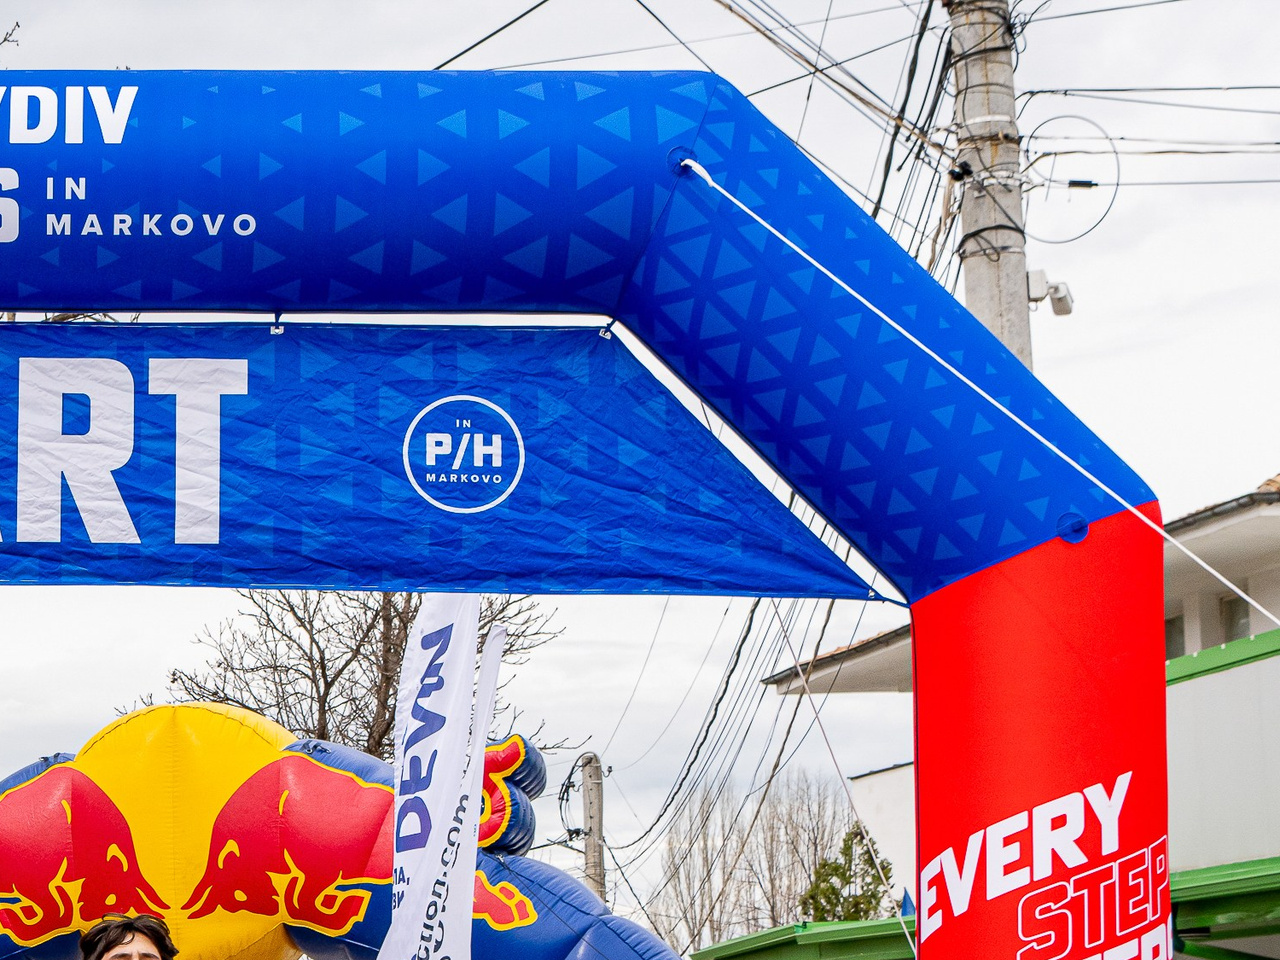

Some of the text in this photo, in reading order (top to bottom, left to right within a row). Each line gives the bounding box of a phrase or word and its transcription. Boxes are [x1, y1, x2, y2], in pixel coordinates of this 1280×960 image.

[46, 177, 87, 200] IN
[46, 213, 258, 237] MARKOVO
[455, 419, 471, 428] IN
[425, 433, 503, 470] P/H
[426, 473, 503, 484] MARKOVO
[920, 771, 1133, 944] EVERY
